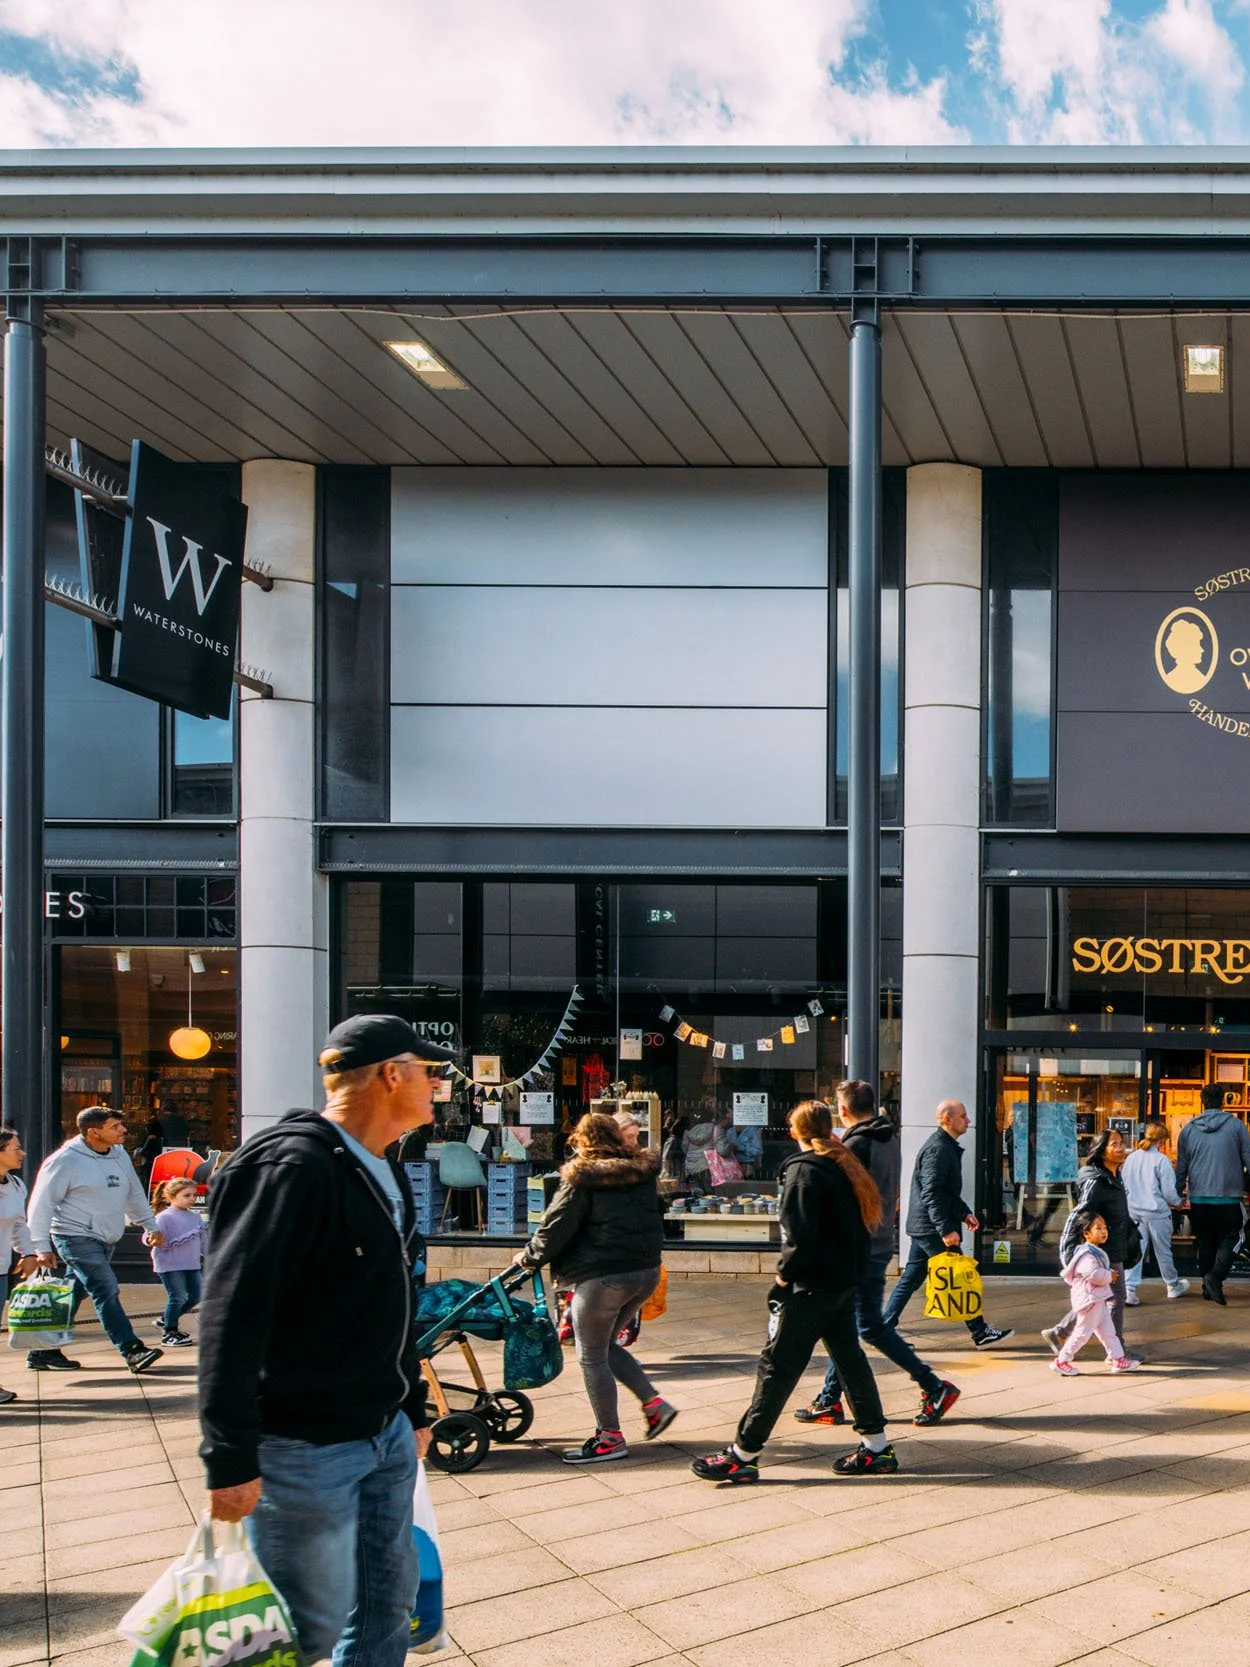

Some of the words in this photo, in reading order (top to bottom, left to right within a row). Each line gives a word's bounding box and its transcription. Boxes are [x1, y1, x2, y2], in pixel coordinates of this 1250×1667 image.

[146, 515, 232, 616] W
[133, 603, 229, 657] WATERSTONES
[9, 1293, 52, 1309] ASDA
[928, 1291, 982, 1317] AND
[168, 1604, 293, 1667] ASDA
